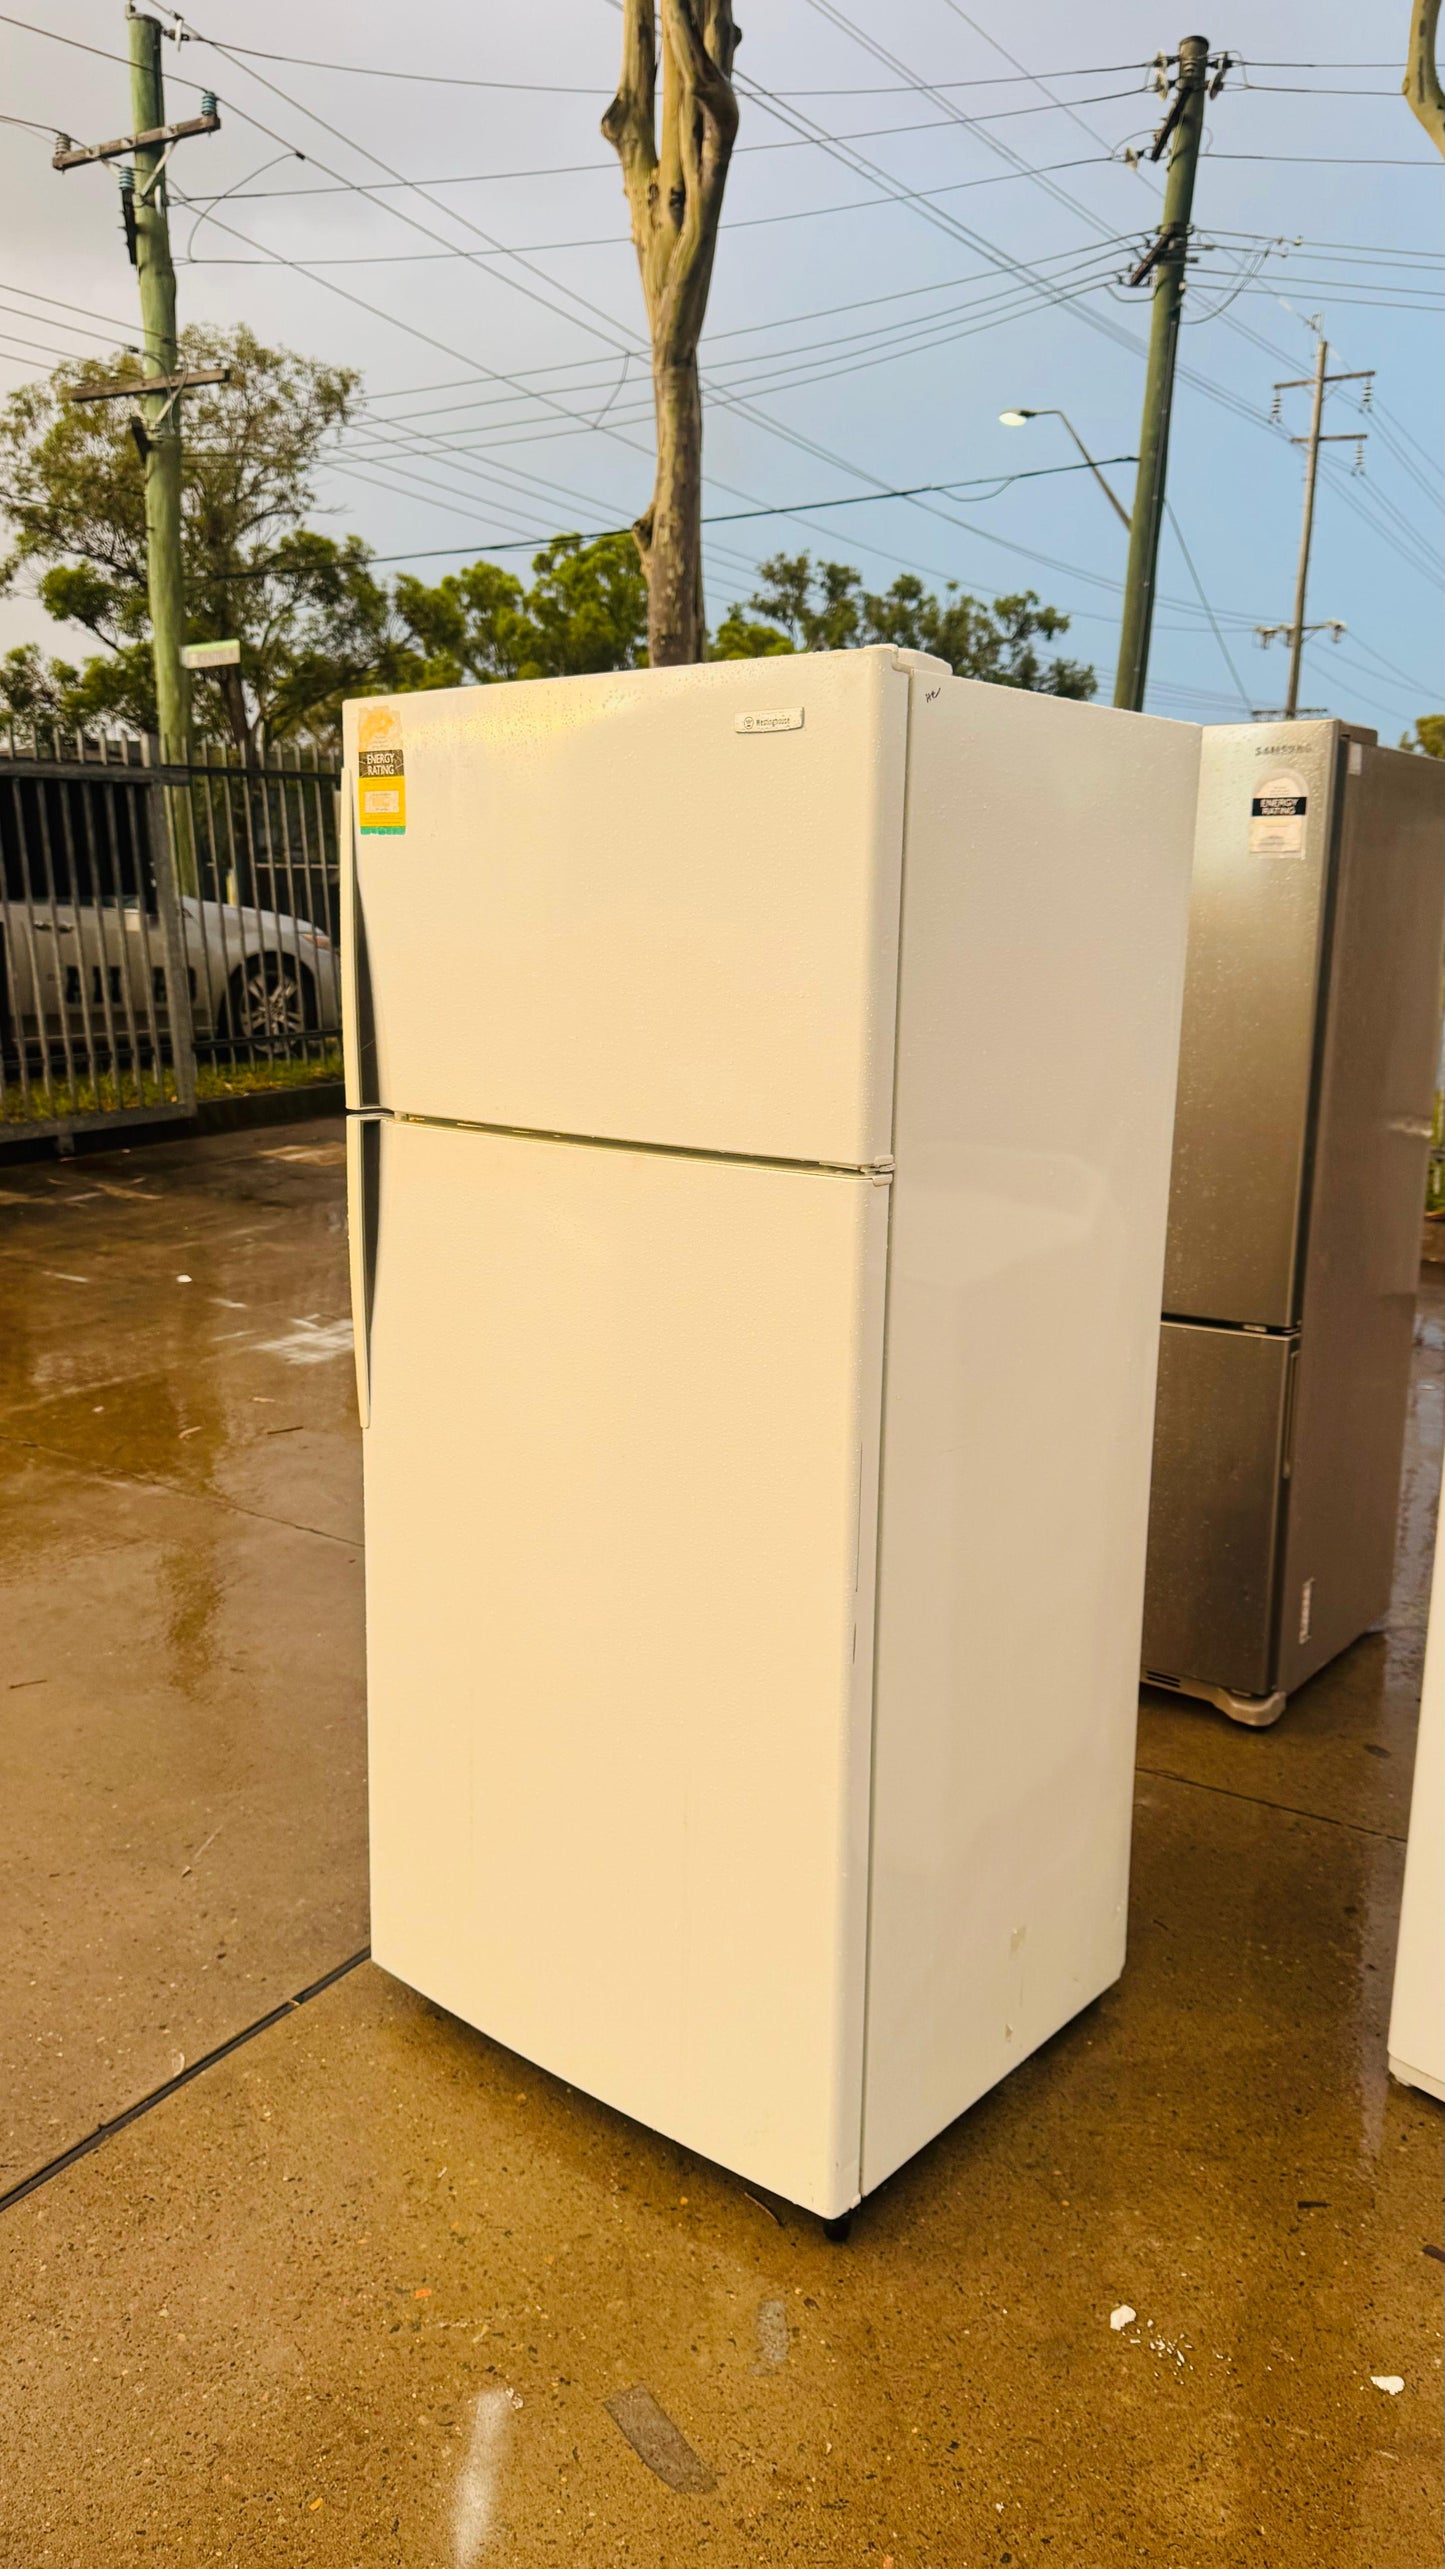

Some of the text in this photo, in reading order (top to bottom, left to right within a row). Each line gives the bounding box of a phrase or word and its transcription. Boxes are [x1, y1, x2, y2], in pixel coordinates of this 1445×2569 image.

[1255, 745, 1312, 756] SAMSUNG
[366, 753, 395, 765] ENERGY
[367, 764, 395, 776] RATING
[1260, 798, 1300, 808] ENERGY
[1261, 807, 1297, 816] RATING
